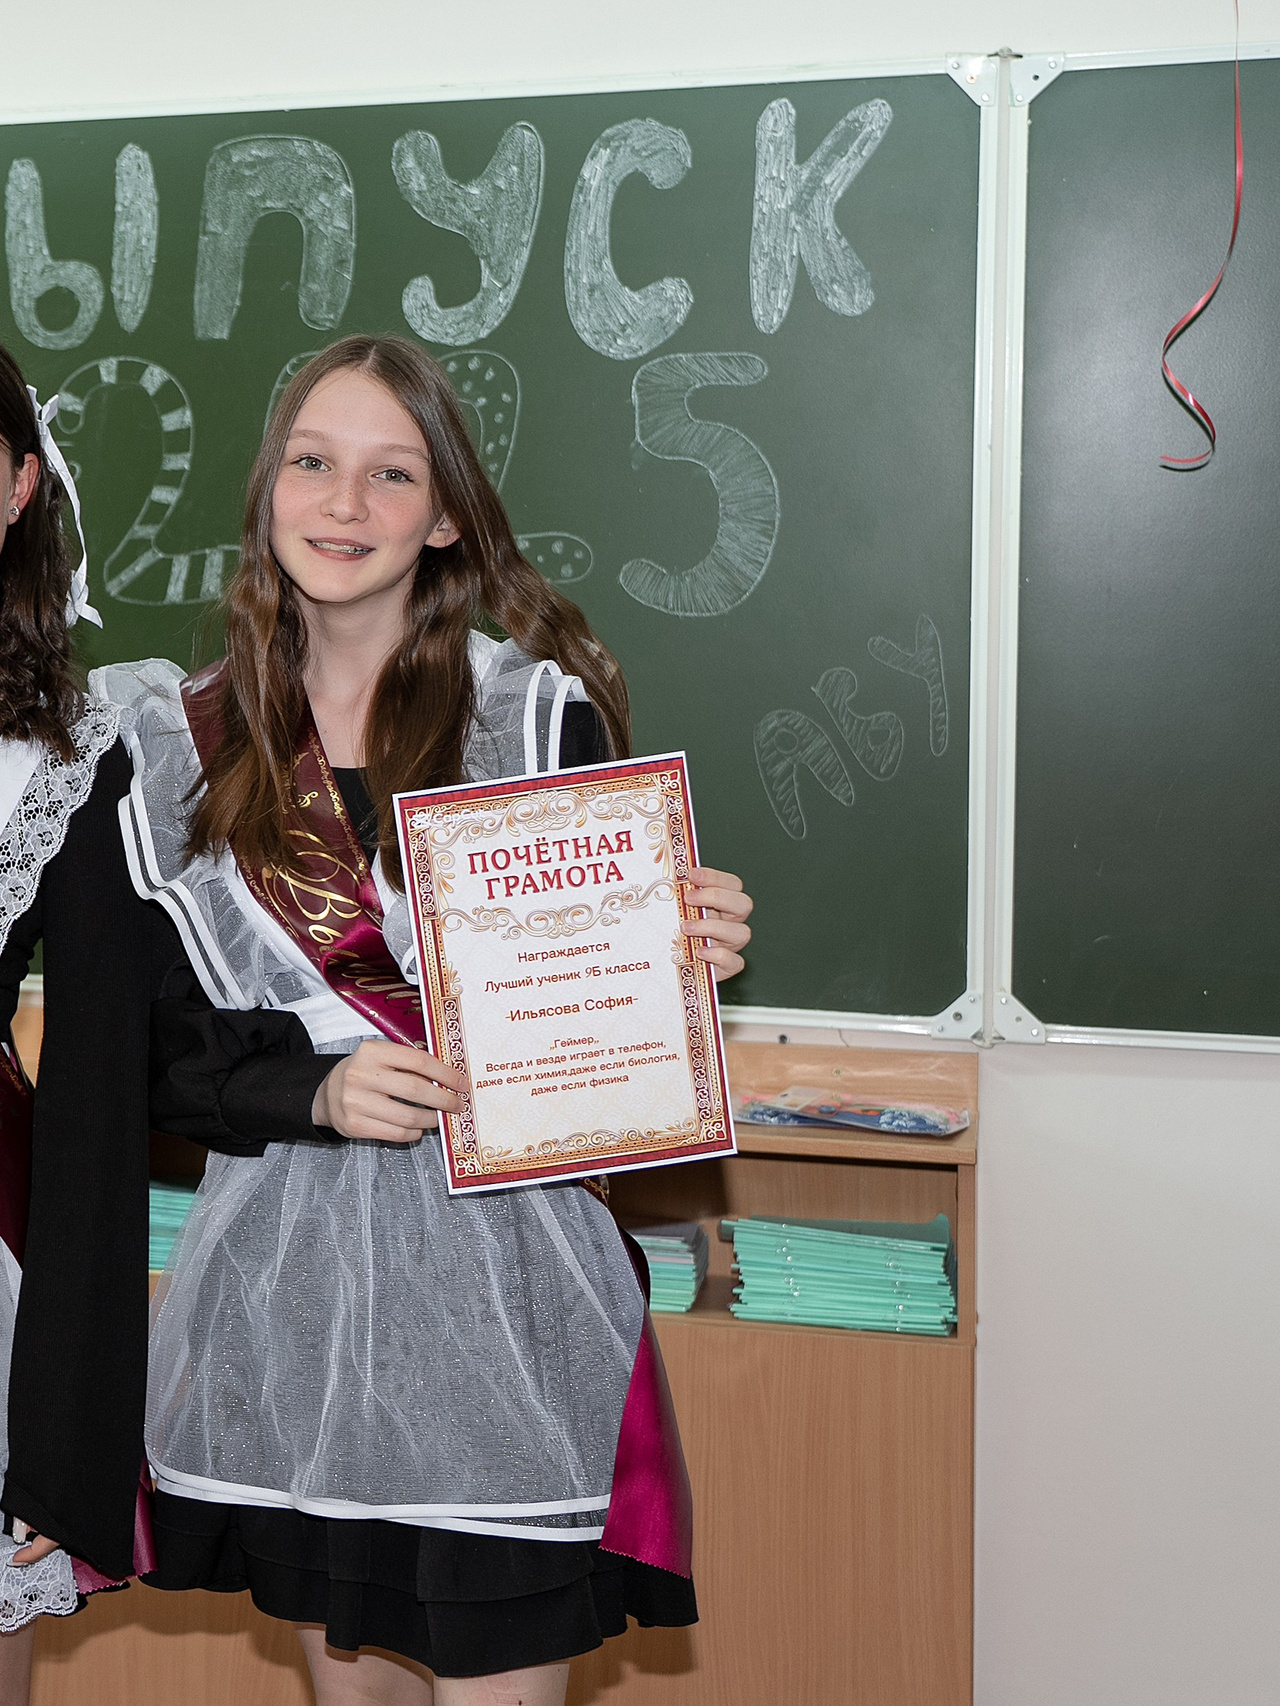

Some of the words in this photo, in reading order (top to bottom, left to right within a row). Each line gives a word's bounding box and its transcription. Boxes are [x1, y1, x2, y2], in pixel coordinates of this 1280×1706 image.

[467, 830, 634, 875] ПОЧЁТНАЯ
[485, 860, 624, 900] ГРАМОТА
[517, 941, 610, 963] Награждается
[484, 975, 533, 993] Лучший
[536, 971, 581, 987] ученик
[585, 965, 602, 979] 9Б
[605, 960, 650, 976] класса
[476, 1076, 503, 1089] даже
[506, 1073, 532, 1084] если
[599, 1061, 625, 1071] если
[627, 1052, 681, 1067] биология,
[486, 1059, 524, 1073] Всегда
[526, 1059, 533, 1067] и
[536, 1054, 567, 1067] везде
[569, 1049, 606, 1063] играет
[608, 1048, 615, 1056] в
[618, 1039, 667, 1054] телефон,
[530, 1084, 558, 1097] даже
[561, 1081, 587, 1092] если
[589, 1074, 630, 1089] физика
